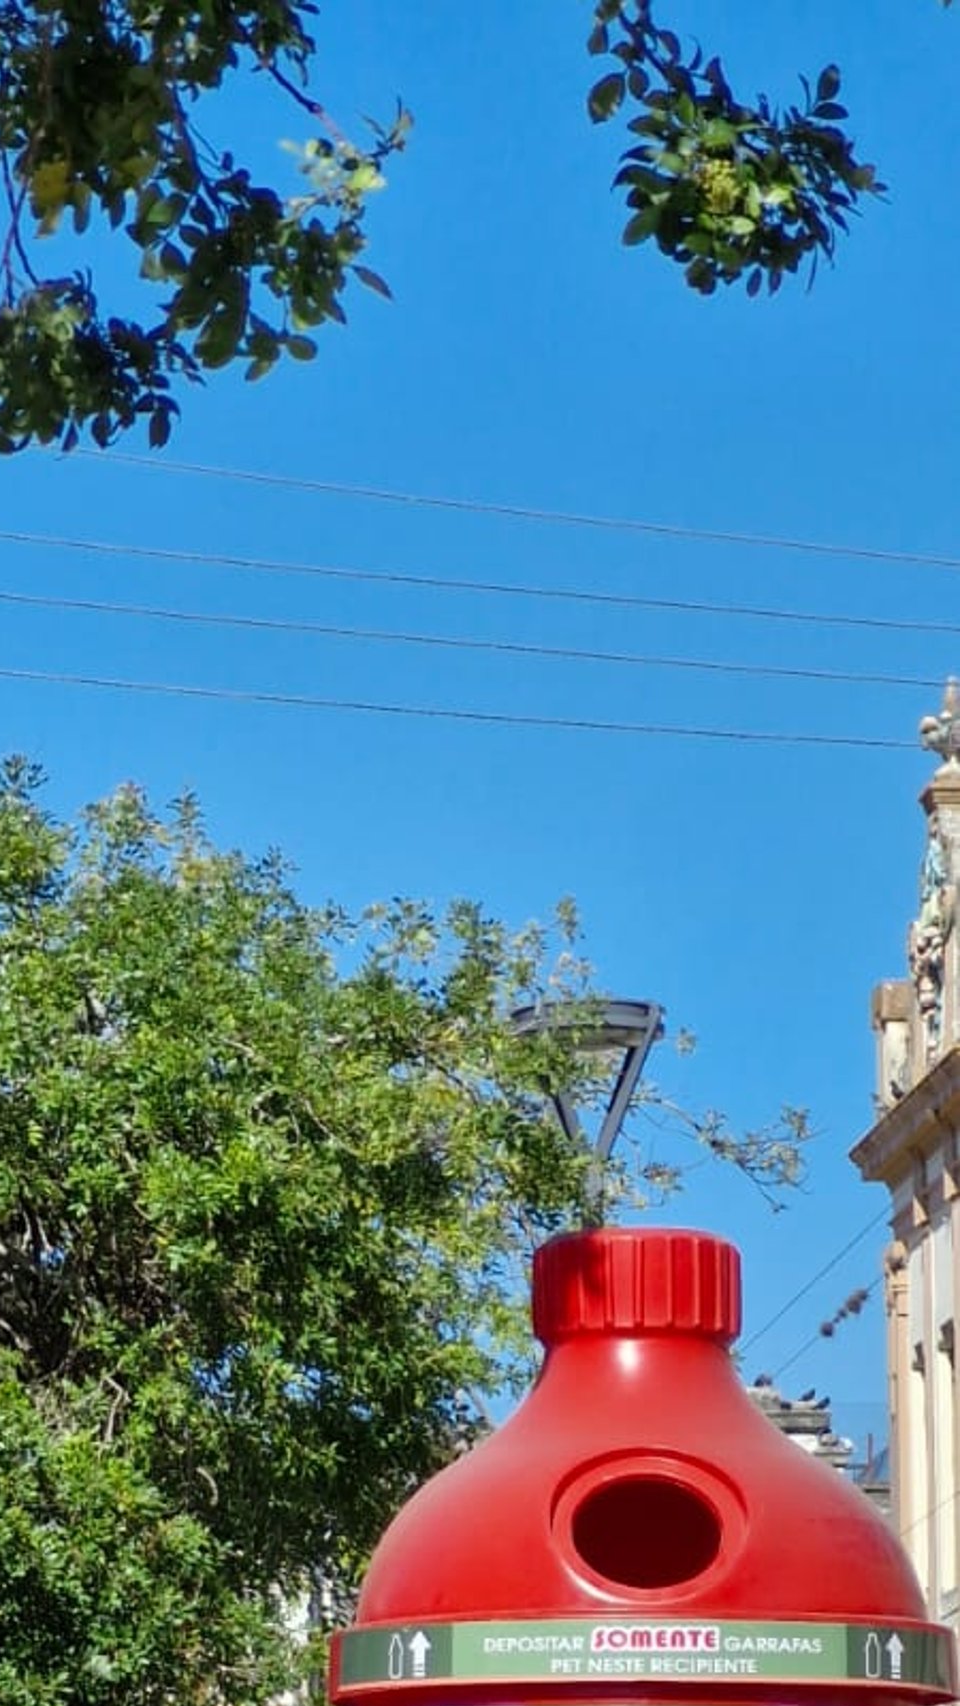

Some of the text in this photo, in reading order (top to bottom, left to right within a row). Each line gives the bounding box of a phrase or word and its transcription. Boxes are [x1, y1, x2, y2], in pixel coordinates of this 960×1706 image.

[483, 1629, 822, 1654] DEPOSITAR SOMENTE GARRAFAS
[551, 1657, 758, 1673] PET NESTE RECIPIENTE
